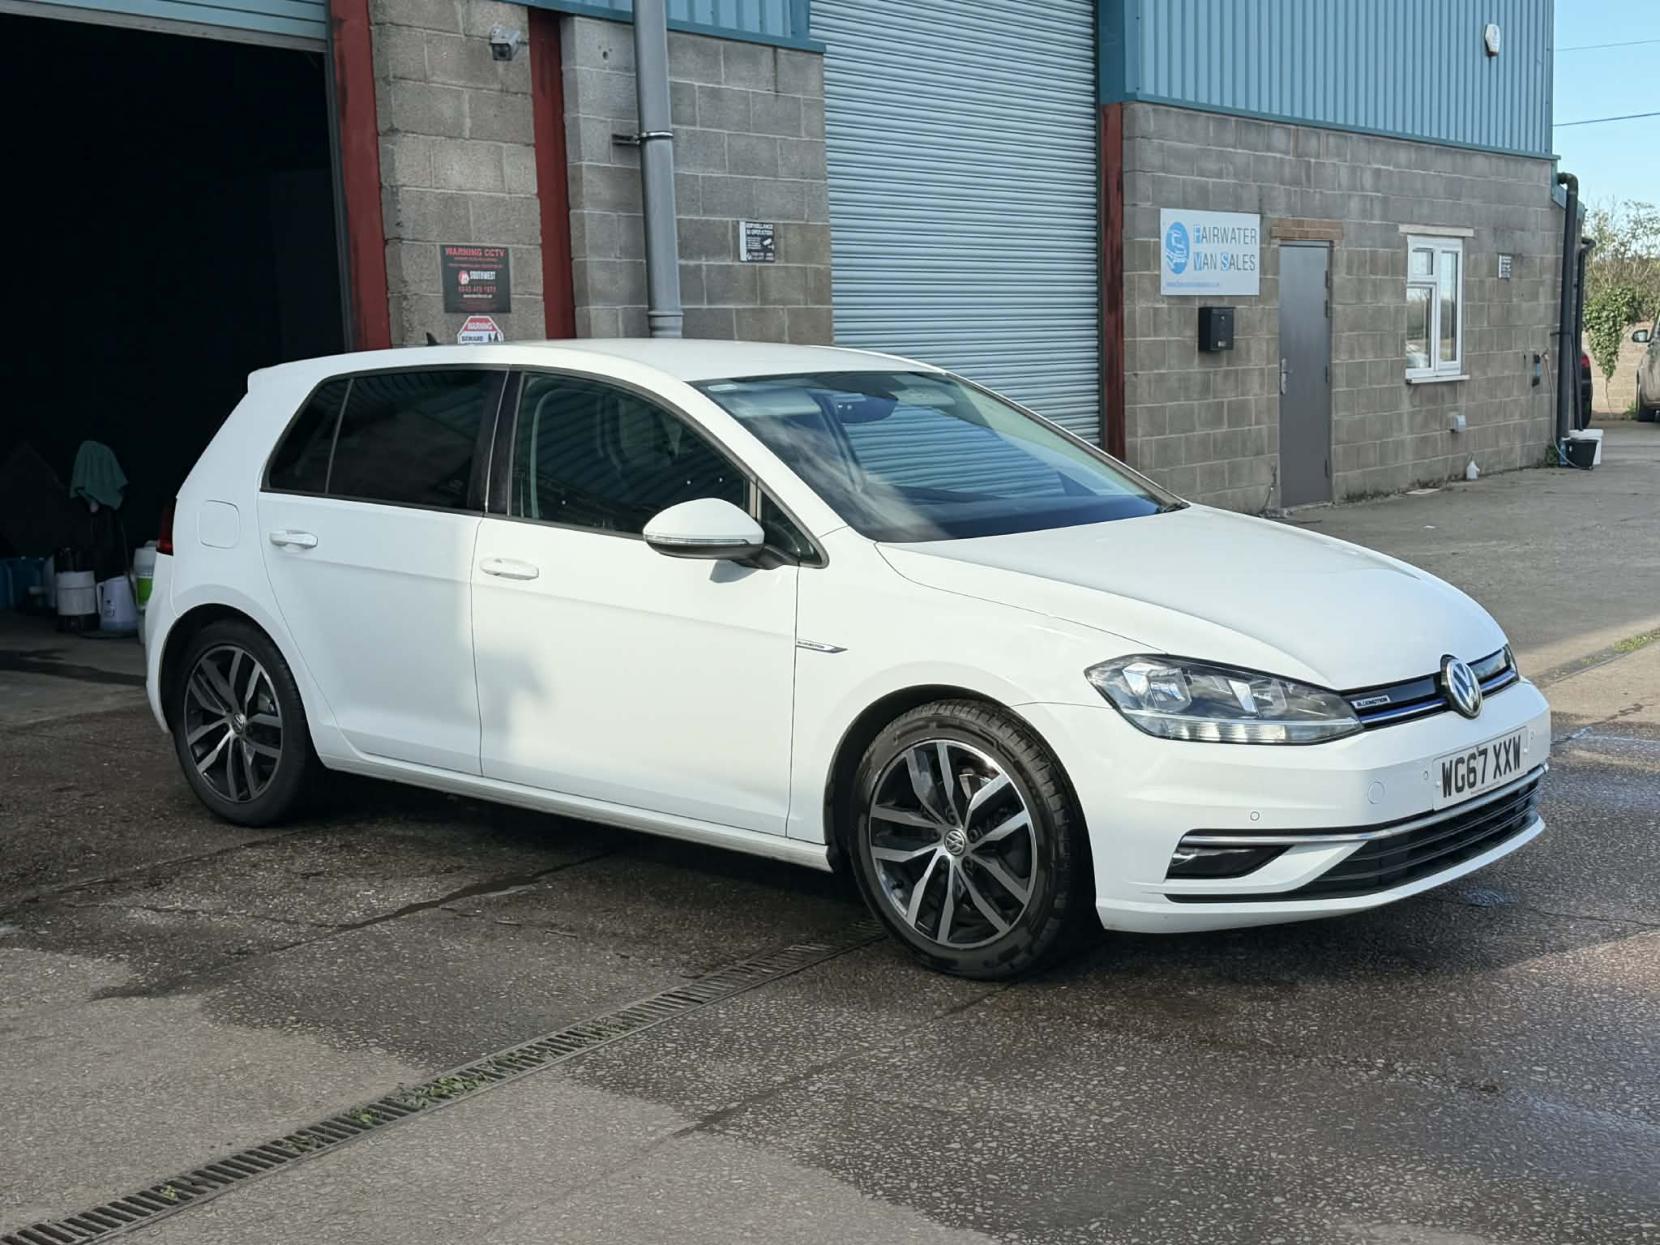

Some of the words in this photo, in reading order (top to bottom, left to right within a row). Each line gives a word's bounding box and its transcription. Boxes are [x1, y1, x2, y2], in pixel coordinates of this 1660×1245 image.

[1193, 224, 1257, 244] FAIRWATER
[445, 247, 482, 257] WARNING
[485, 248, 505, 257] CCTV
[1193, 252, 1217, 272] VAN
[1221, 252, 1256, 272] SALES
[1441, 747, 1489, 799] WG67
[1492, 734, 1522, 780] XXW
